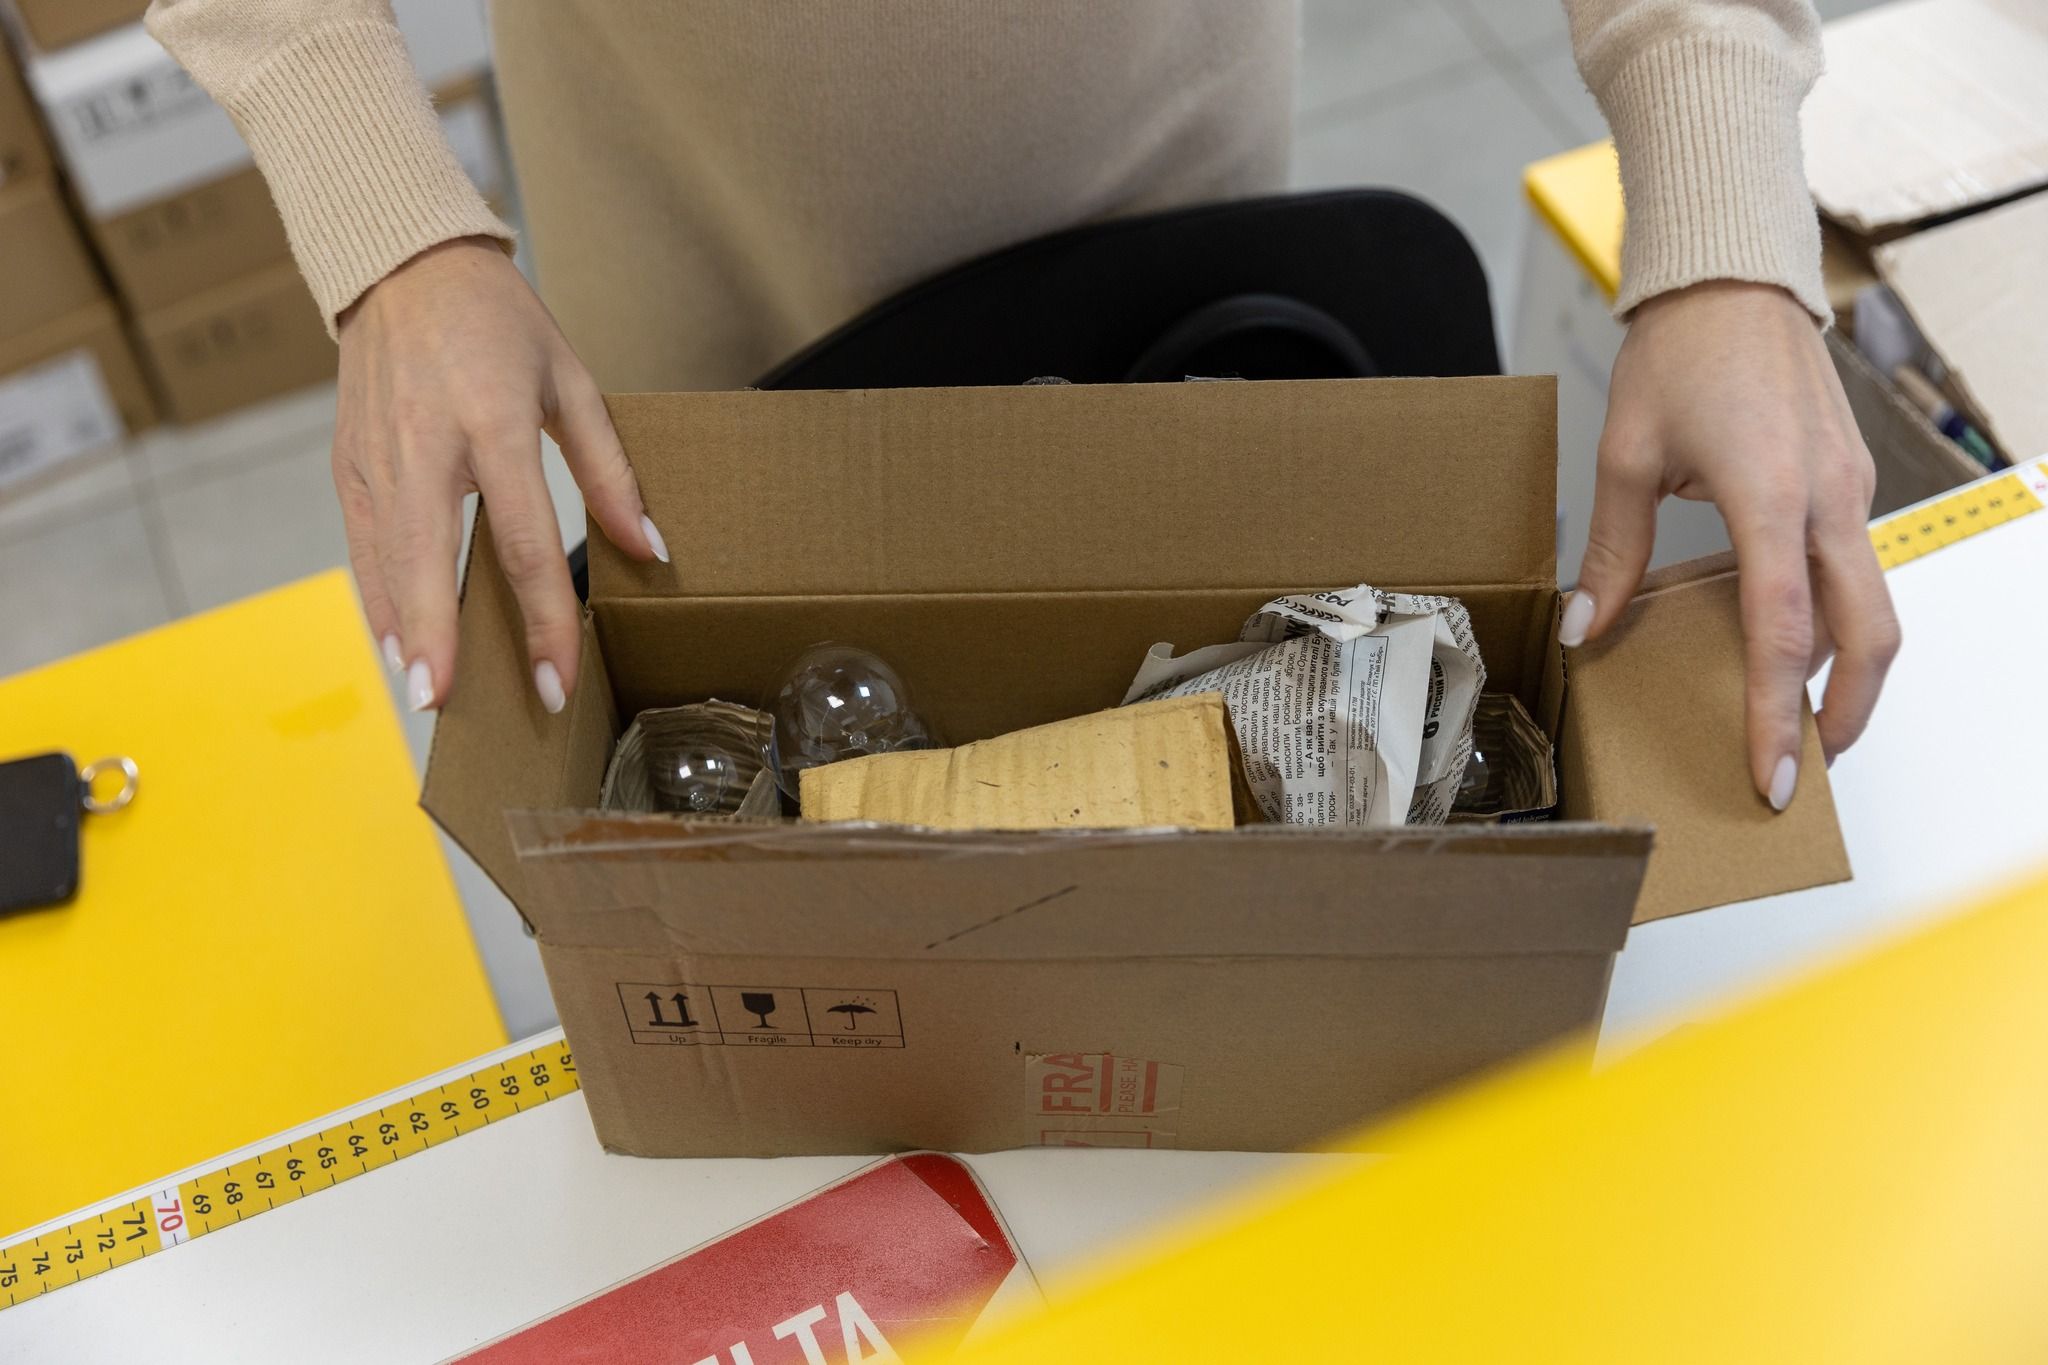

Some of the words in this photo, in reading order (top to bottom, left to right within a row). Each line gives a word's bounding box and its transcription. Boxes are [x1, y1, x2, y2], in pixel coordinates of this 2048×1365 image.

[1309, 592, 1354, 607] РОЗ
[1285, 651, 1296, 678] зброю,
[1309, 646, 1320, 673] жителі
[1319, 638, 1332, 666] міста?
[1331, 662, 1341, 677] були
[1241, 679, 1250, 714] костюми
[1252, 679, 1260, 704] звідти
[1263, 674, 1271, 711] каналах.
[1272, 667, 1282, 701] робили.
[1305, 674, 1316, 716] знаходили
[1318, 667, 1329, 713] окупованого
[1330, 680, 1340, 696] групі
[1283, 684, 1293, 725] російську
[1292, 673, 1304, 725] безпілотника
[1272, 703, 1280, 724] наші
[1272, 726, 1281, 753] ходок
[1307, 738, 1313, 750] як
[1316, 723, 1324, 753] вийти
[1327, 739, 1336, 755] Так
[1240, 724, 1258, 783] одягнувшись
[1283, 733, 1293, 779] виносили
[1294, 727, 1304, 779] прихопили
[1305, 752, 1313, 760] А
[1317, 756, 1325, 777] щоб
[1284, 794, 1294, 824] росіян
[1307, 792, 1313, 804] на
[1328, 792, 1337, 822] проси-
[669, 1034, 686, 1044] Up
[748, 1034, 787, 1045] Fragile
[832, 1036, 859, 1046] Keep
[865, 1037, 882, 1046] dry
[1042, 1054, 1094, 1113] FRA
[1118, 1076, 1136, 1113] PLEASE
[0, 1263, 18, 1288] 75
[32, 1252, 51, 1275] 74
[65, 1239, 84, 1264] 73
[97, 1228, 116, 1253] 72
[122, 1211, 148, 1241] 71
[157, 1199, 183, 1232] 70
[192, 1194, 212, 1215] 69
[224, 1182, 244, 1205] 68
[256, 1171, 275, 1189] 67
[286, 1158, 306, 1181] 66
[317, 1147, 338, 1169] 65
[348, 1135, 368, 1157] 64
[379, 1123, 399, 1145] 63
[409, 1111, 430, 1134] 62
[440, 1101, 460, 1120] 61
[470, 1088, 490, 1110] 60
[500, 1075, 520, 1096] 59
[530, 1063, 550, 1087] 58
